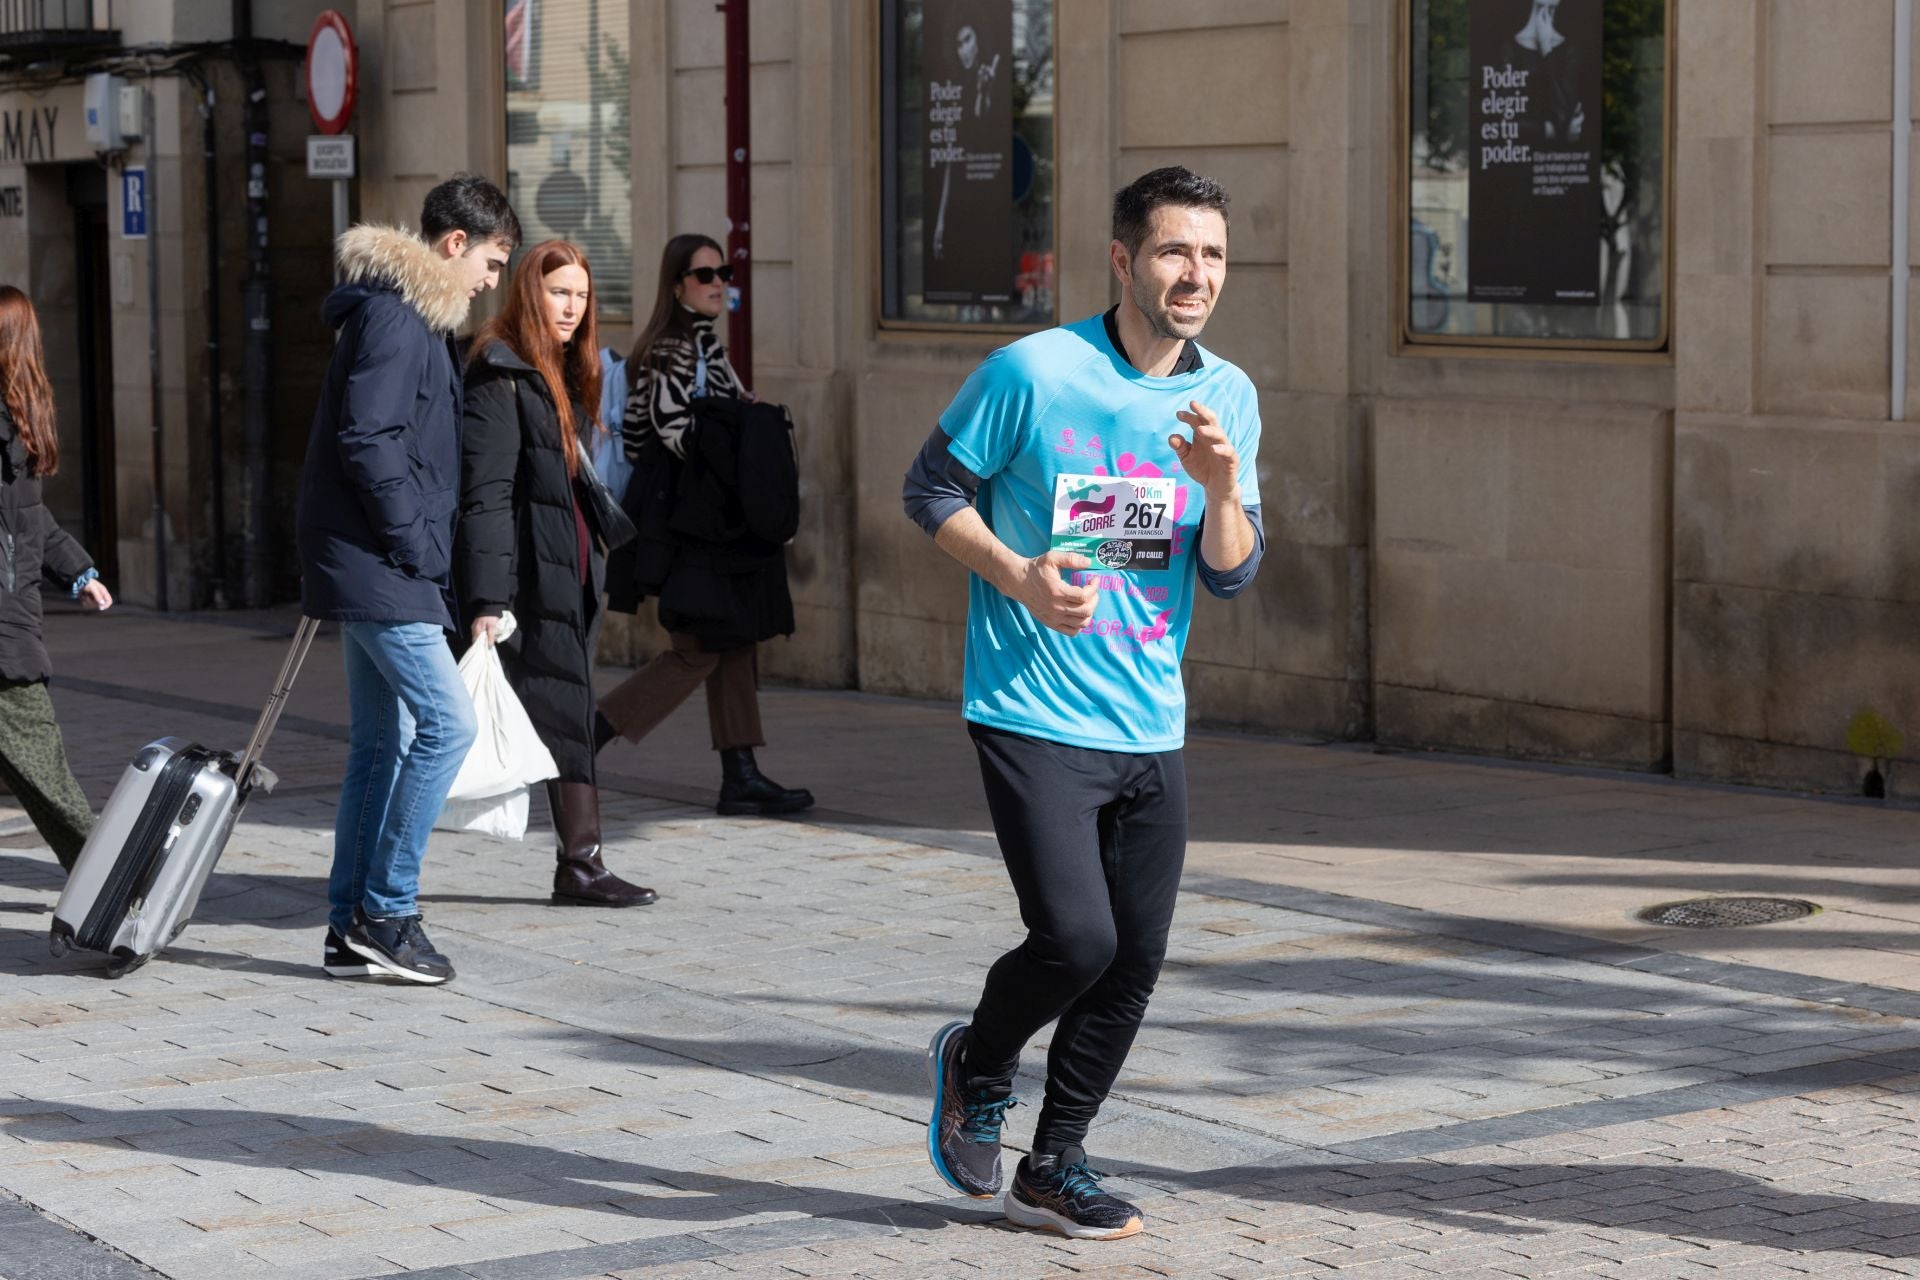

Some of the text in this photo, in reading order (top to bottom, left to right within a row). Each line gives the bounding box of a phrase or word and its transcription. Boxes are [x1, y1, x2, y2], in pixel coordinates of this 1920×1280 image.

[1482, 63, 1529, 89] Poder
[930, 79, 963, 101] Poder
[929, 101, 963, 127] elegir
[1481, 90, 1529, 120] elegir
[0, 105, 59, 161] MAY
[1481, 118, 1519, 140] es tu
[1481, 139, 1532, 170] poder.
[126, 175, 142, 213] R
[1134, 486, 1162, 499] 10Km
[1068, 520, 1081, 536] SE
[1082, 514, 1117, 533] CORRE
[1123, 502, 1167, 529] 267
